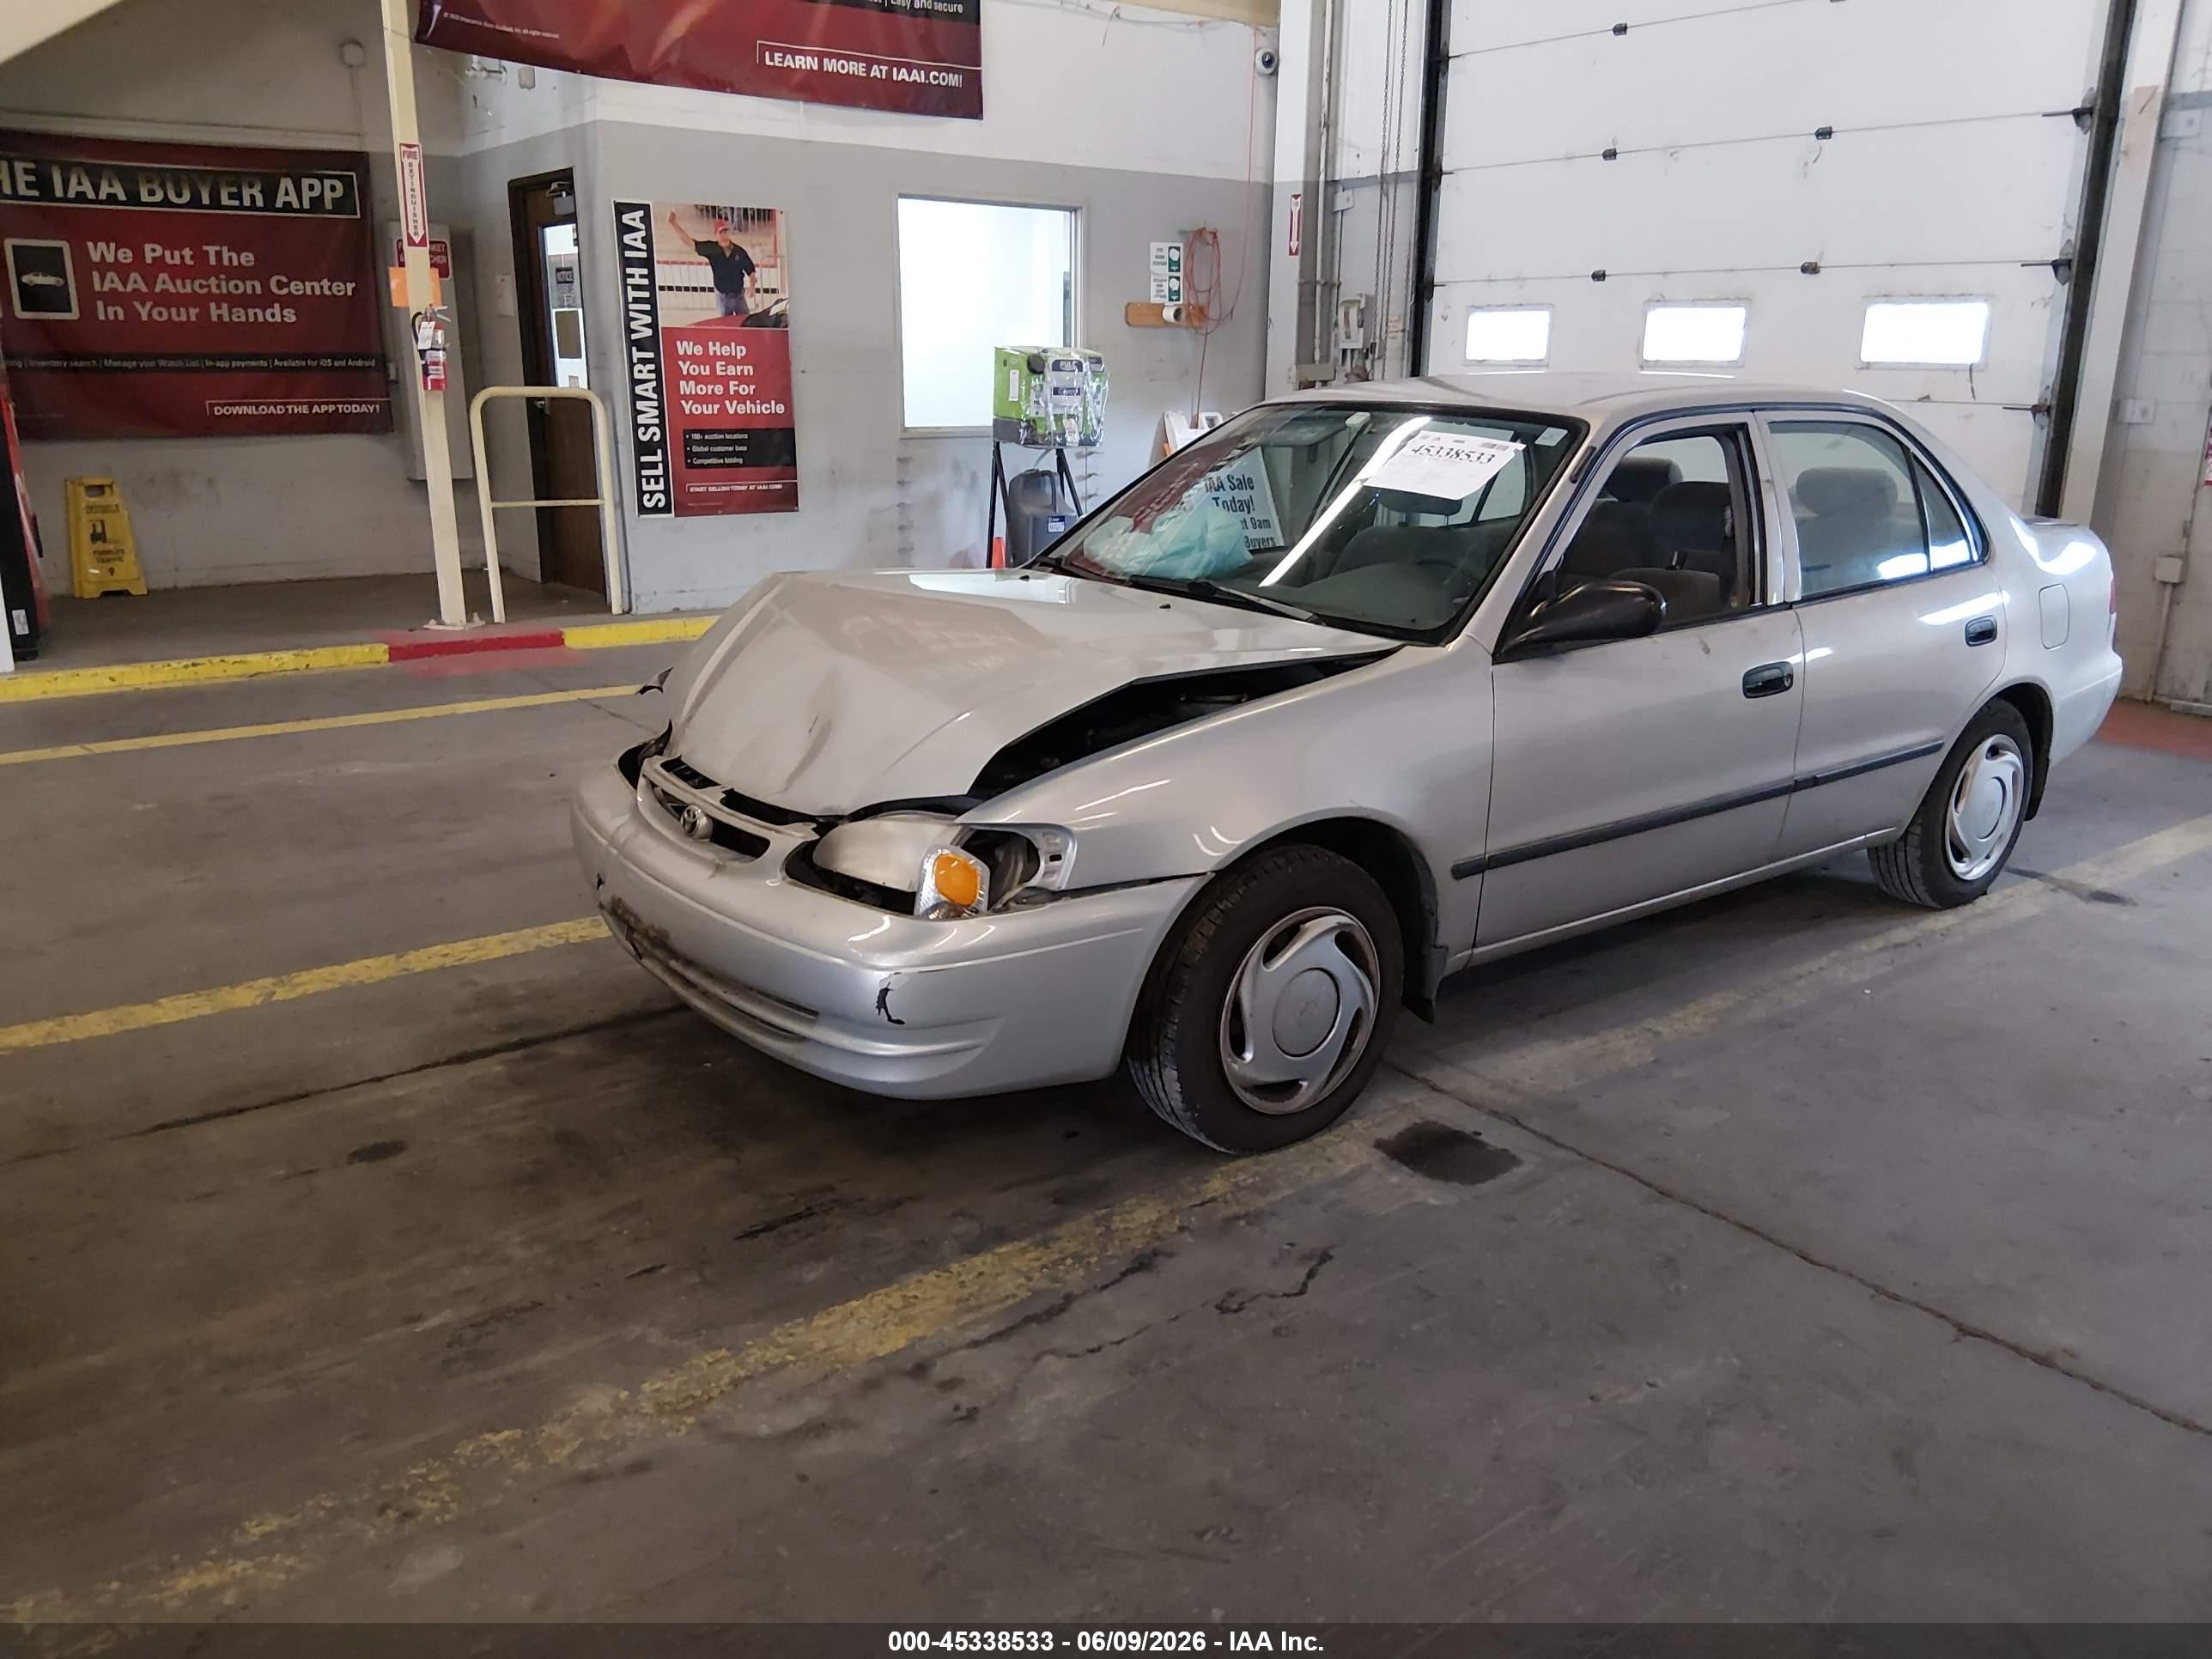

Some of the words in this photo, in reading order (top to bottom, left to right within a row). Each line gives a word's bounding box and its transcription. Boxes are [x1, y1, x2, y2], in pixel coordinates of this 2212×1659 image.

[914, 0, 933, 9] and
[933, 2, 963, 13] secure
[765, 51, 817, 70] LEARN
[823, 58, 866, 76] MORE
[870, 64, 888, 79] AT
[892, 67, 963, 88] IAAI.COM!
[402, 150, 418, 160] FIRE
[52, 164, 127, 201] IAA
[137, 171, 264, 208] BUYER
[275, 177, 343, 210] APP
[408, 161, 420, 237] EXTINGUISHER
[623, 210, 647, 258] IAA
[87, 241, 133, 263] We
[144, 243, 194, 265] Put
[203, 246, 255, 266] The
[92, 270, 149, 293] IAA
[155, 272, 261, 295] Auction
[270, 275, 356, 295] Center
[97, 301, 125, 321] In
[133, 301, 199, 321] Your
[210, 302, 297, 323] Hands
[625, 267, 651, 340] WITH
[677, 341, 703, 356] We
[708, 341, 746, 359] Help
[205, 359, 229, 368] In-app
[232, 359, 268, 368] payments
[274, 359, 306, 368] Available
[307, 359, 319, 368] for
[333, 359, 346, 368] and
[348, 359, 376, 368] Android
[678, 361, 710, 375] You
[716, 361, 754, 375] Earn
[632, 346, 660, 442] SMART
[679, 380, 724, 395] More
[729, 380, 756, 395] For
[214, 404, 289, 416] DOWNLOAD
[287, 404, 309, 415] THE
[312, 404, 337, 414] APP
[337, 404, 380, 414] TODAY!
[680, 400, 720, 415] Your
[725, 400, 785, 414] Vehicle
[725, 456, 744, 465] bidding
[1412, 443, 1496, 465] 45338533
[641, 448, 666, 508] SELL
[1204, 476, 1226, 494] IAA
[1227, 473, 1255, 492] Sale
[1212, 495, 1255, 514] Today!
[1250, 517, 1271, 530] 9am
[1244, 535, 1276, 549] Buyers
